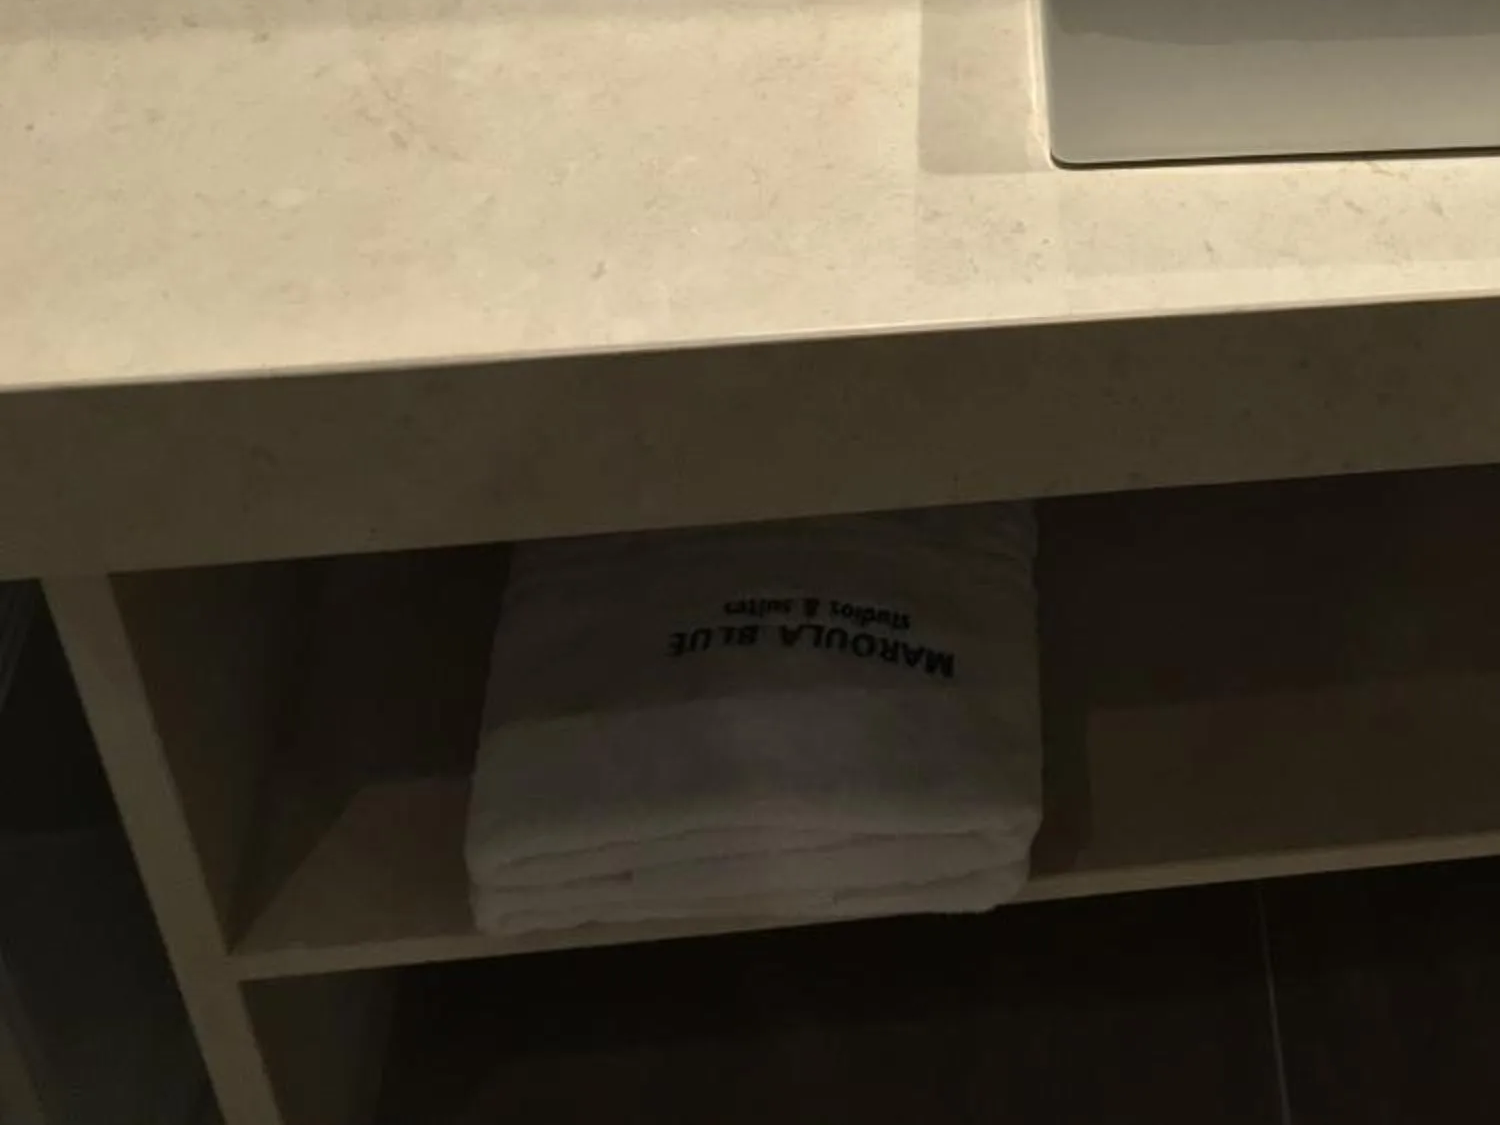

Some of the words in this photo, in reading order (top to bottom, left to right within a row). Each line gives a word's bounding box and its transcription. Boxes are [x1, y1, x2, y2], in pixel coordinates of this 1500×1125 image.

[723, 598, 794, 618] suites
[802, 598, 821, 618] &
[829, 599, 912, 631] studios
[664, 625, 761, 658] BLUE
[778, 624, 955, 679] MAROULA
